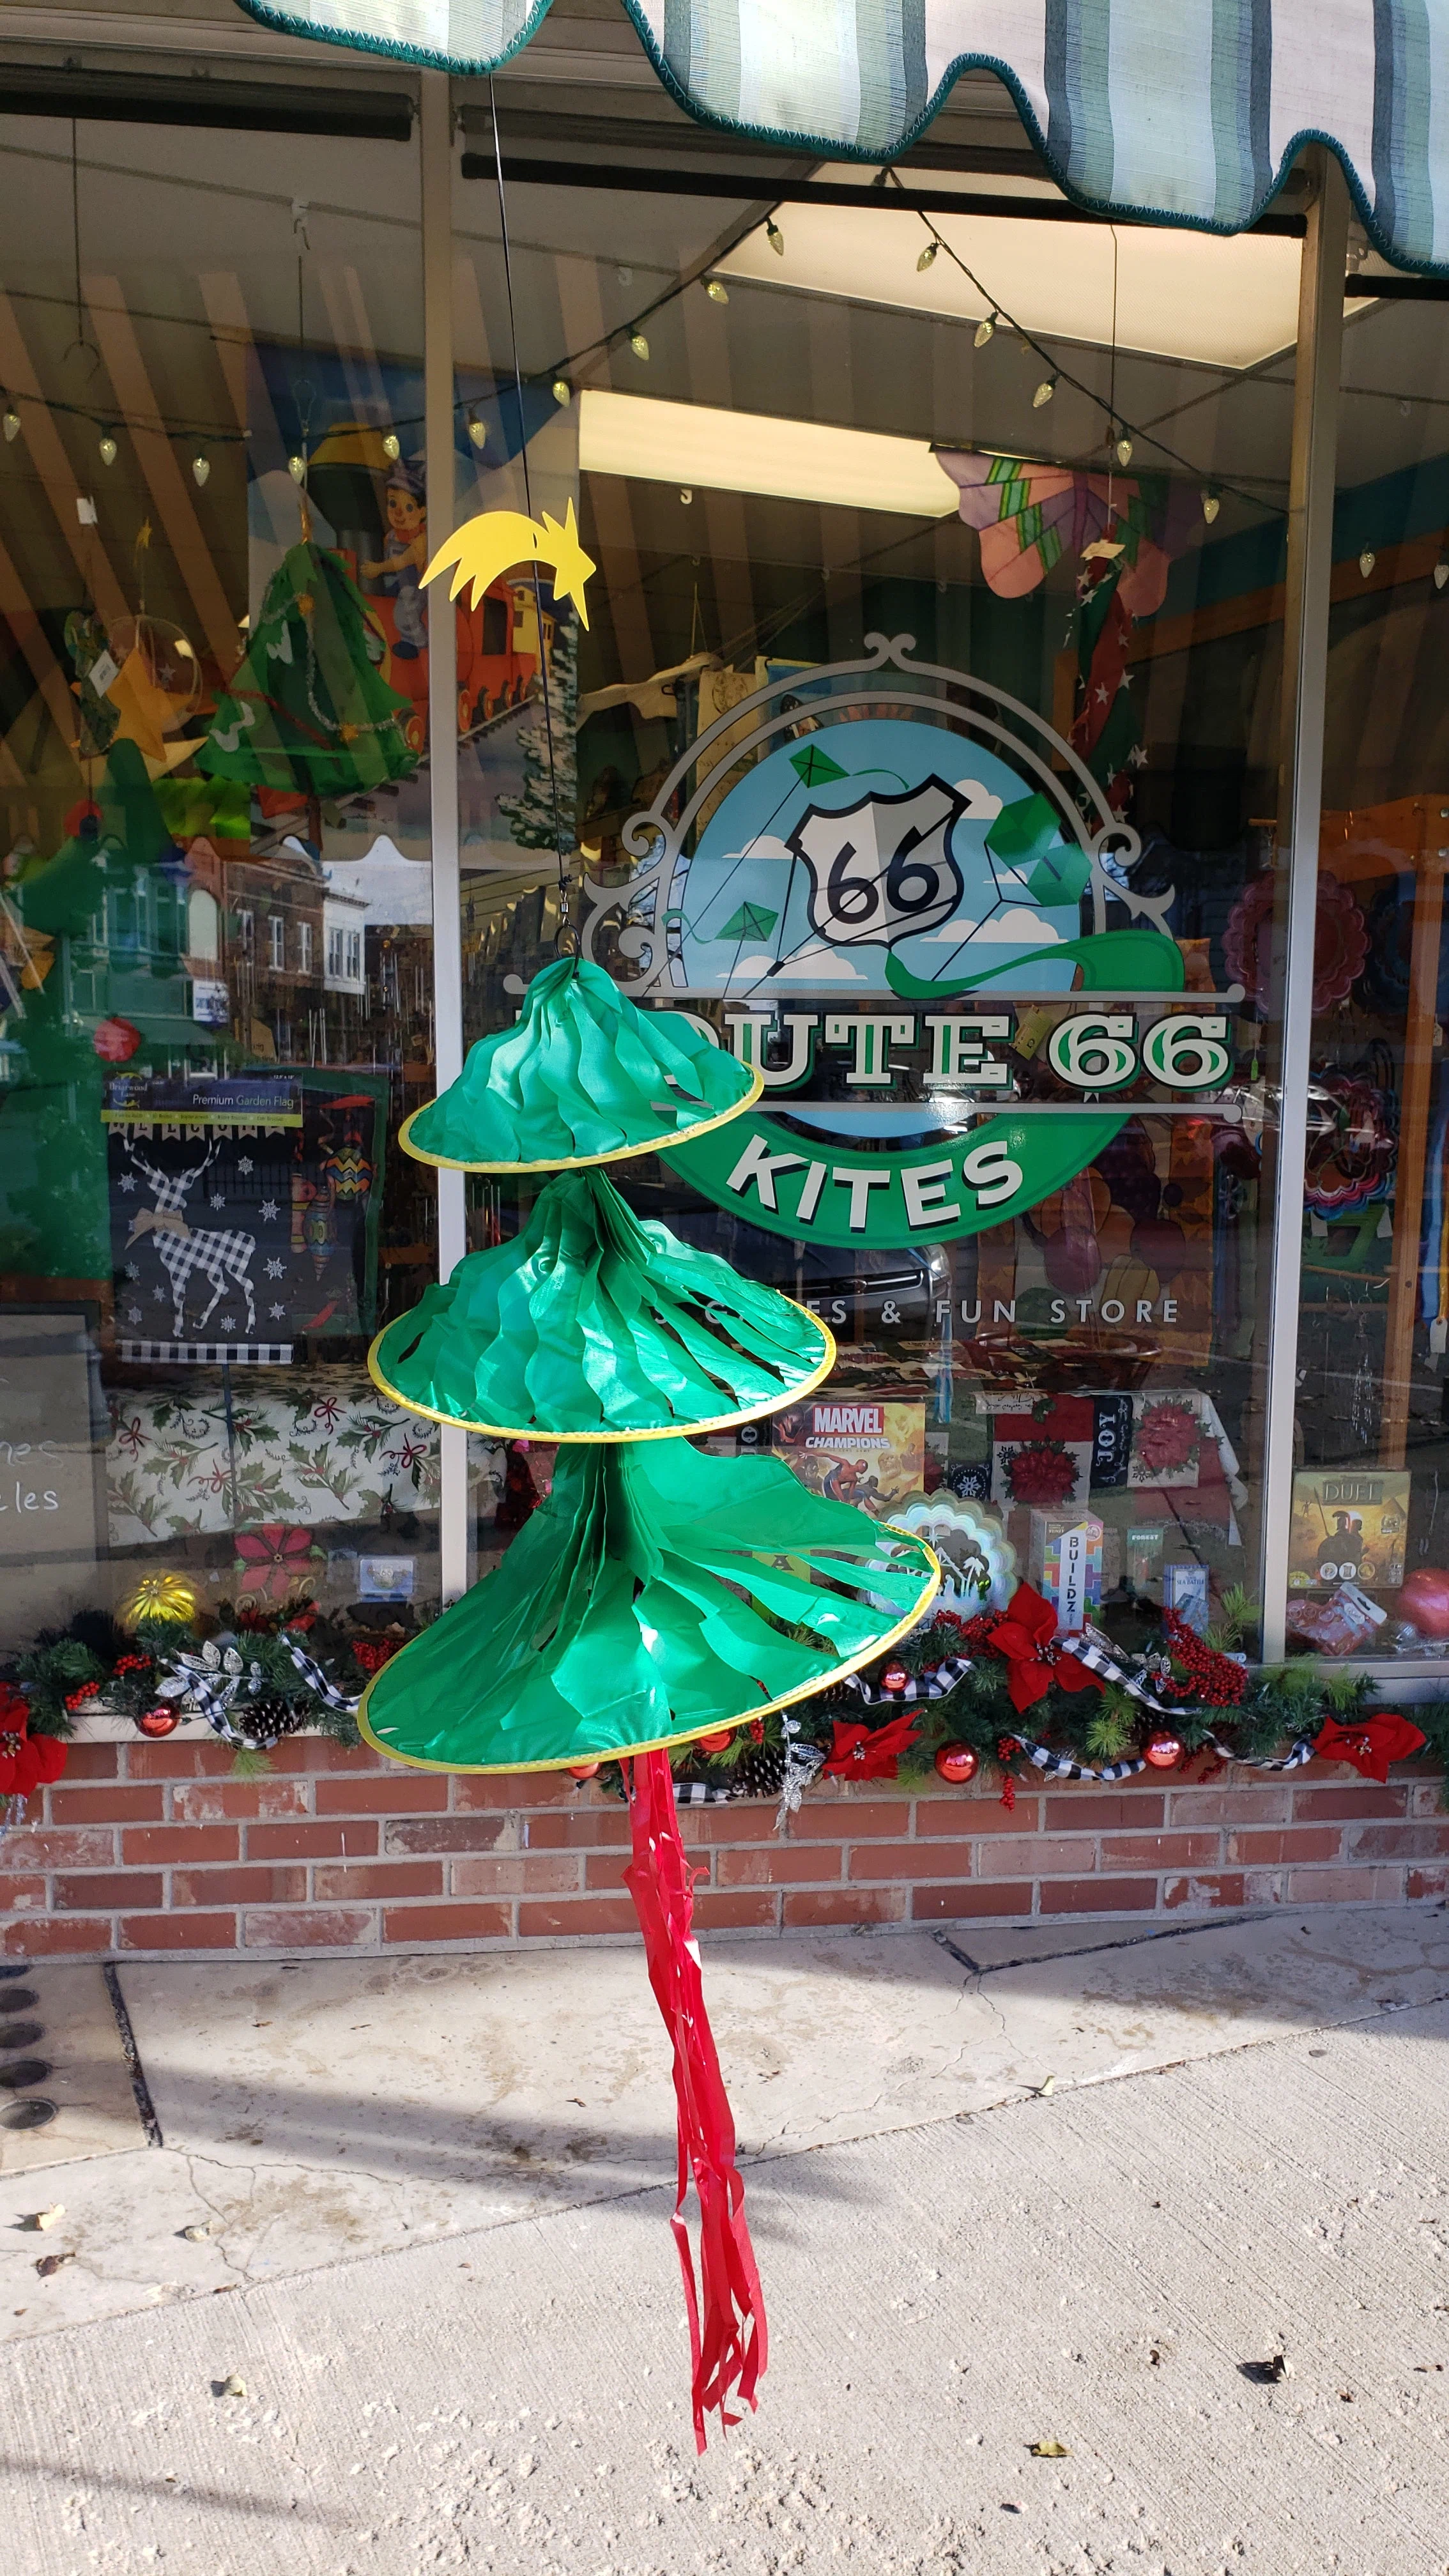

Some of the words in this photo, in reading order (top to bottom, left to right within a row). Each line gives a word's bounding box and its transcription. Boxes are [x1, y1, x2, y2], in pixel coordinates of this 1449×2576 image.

[827, 825, 940, 925] 66
[664, 1008, 1016, 1092] UTE
[1046, 1011, 1235, 1093] 66
[193, 1094, 234, 1105] Premium
[236, 1095, 271, 1106] Garden
[274, 1096, 294, 1109] Flag
[726, 1134, 1024, 1236] KITES
[880, 1300, 901, 1324] &
[936, 1299, 1016, 1324] FUN
[1050, 1298, 1178, 1324] STORE
[814, 1407, 882, 1434] MARVEL
[805, 1436, 891, 1449] CHAMPIONS
[1095, 1411, 1117, 1467] JOY
[1325, 1483, 1383, 1501] DUEL
